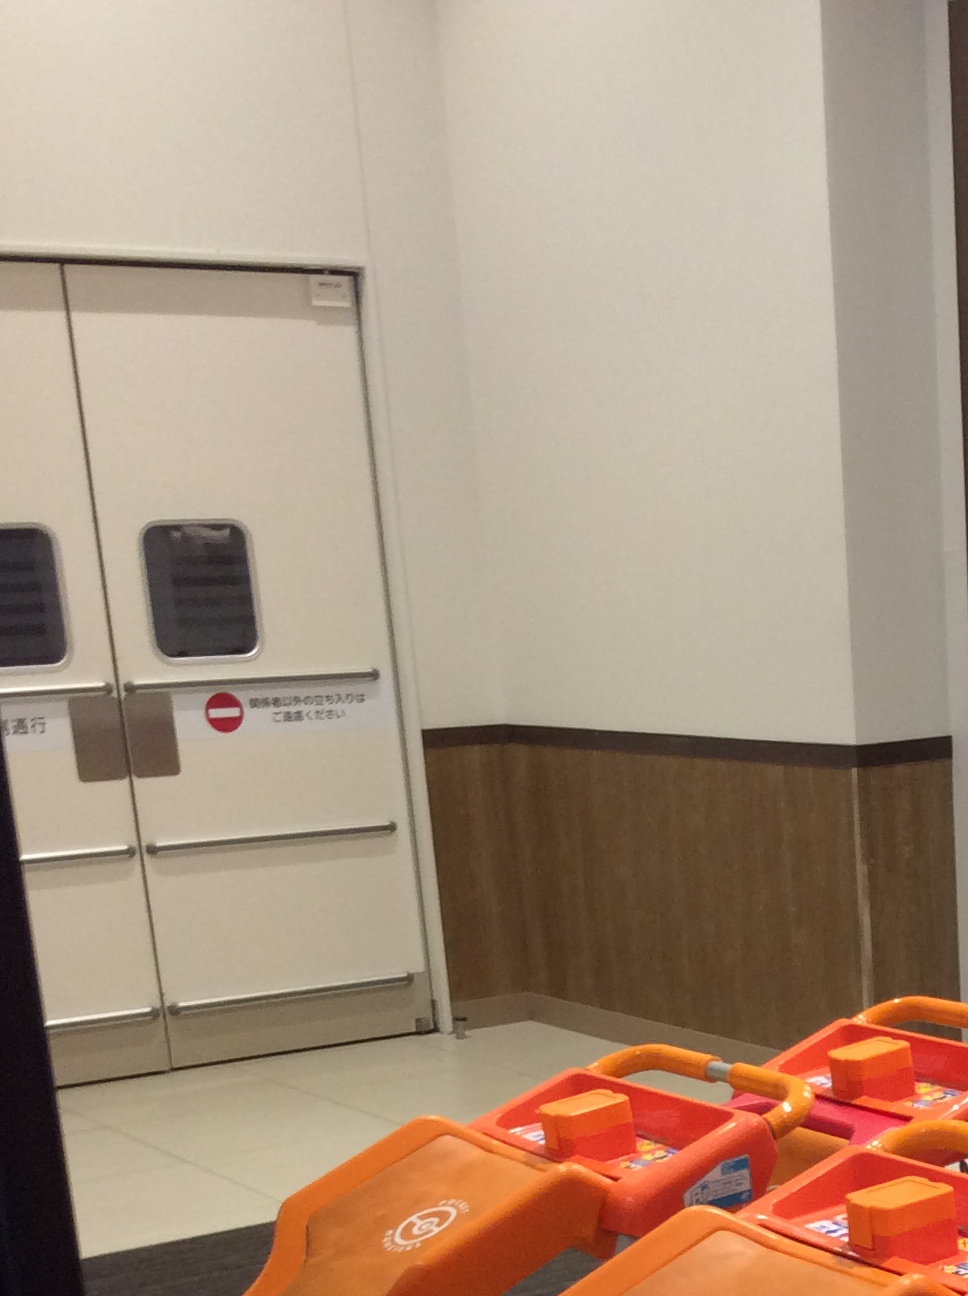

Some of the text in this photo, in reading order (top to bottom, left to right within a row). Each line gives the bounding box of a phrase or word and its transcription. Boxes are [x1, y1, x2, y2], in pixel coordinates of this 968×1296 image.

[248, 693, 366, 709] 関係者以外の立ち入りは
